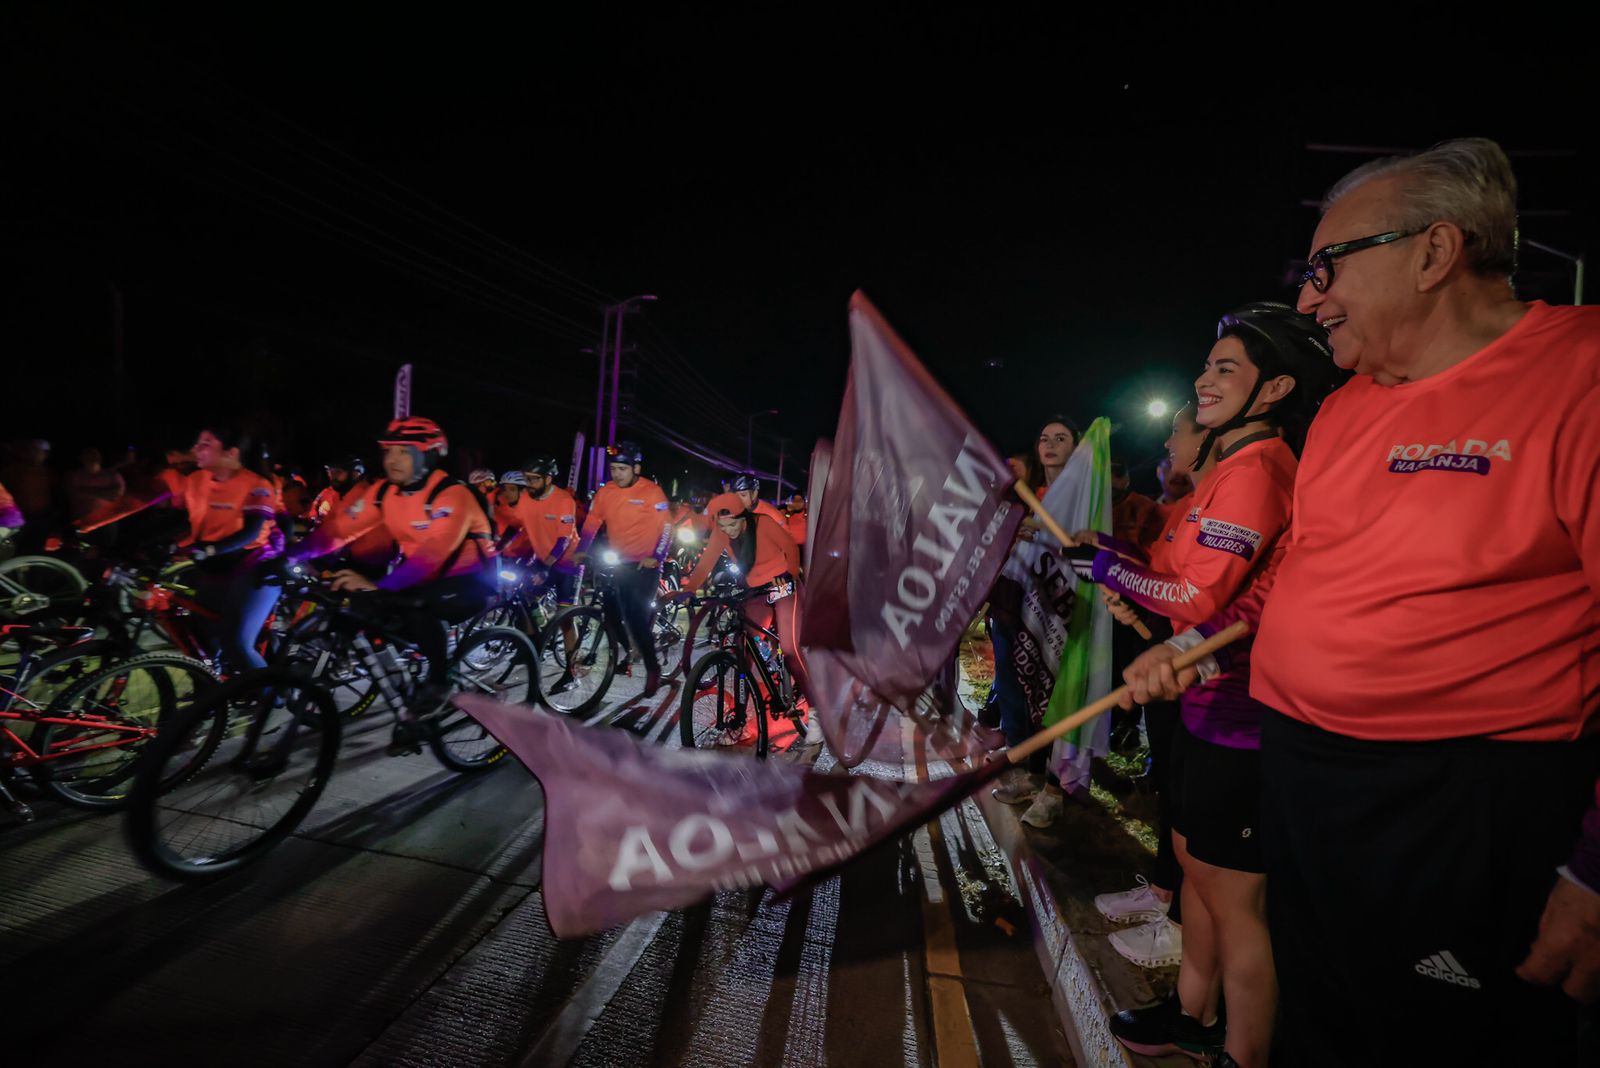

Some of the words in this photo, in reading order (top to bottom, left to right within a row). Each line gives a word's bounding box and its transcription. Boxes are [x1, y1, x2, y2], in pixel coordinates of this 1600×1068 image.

[1386, 439, 1513, 462] RODADA
[1231, 526, 1251, 535] PONER
[1202, 535, 1246, 553] MUJERES
[1414, 963, 1482, 990] adidas
